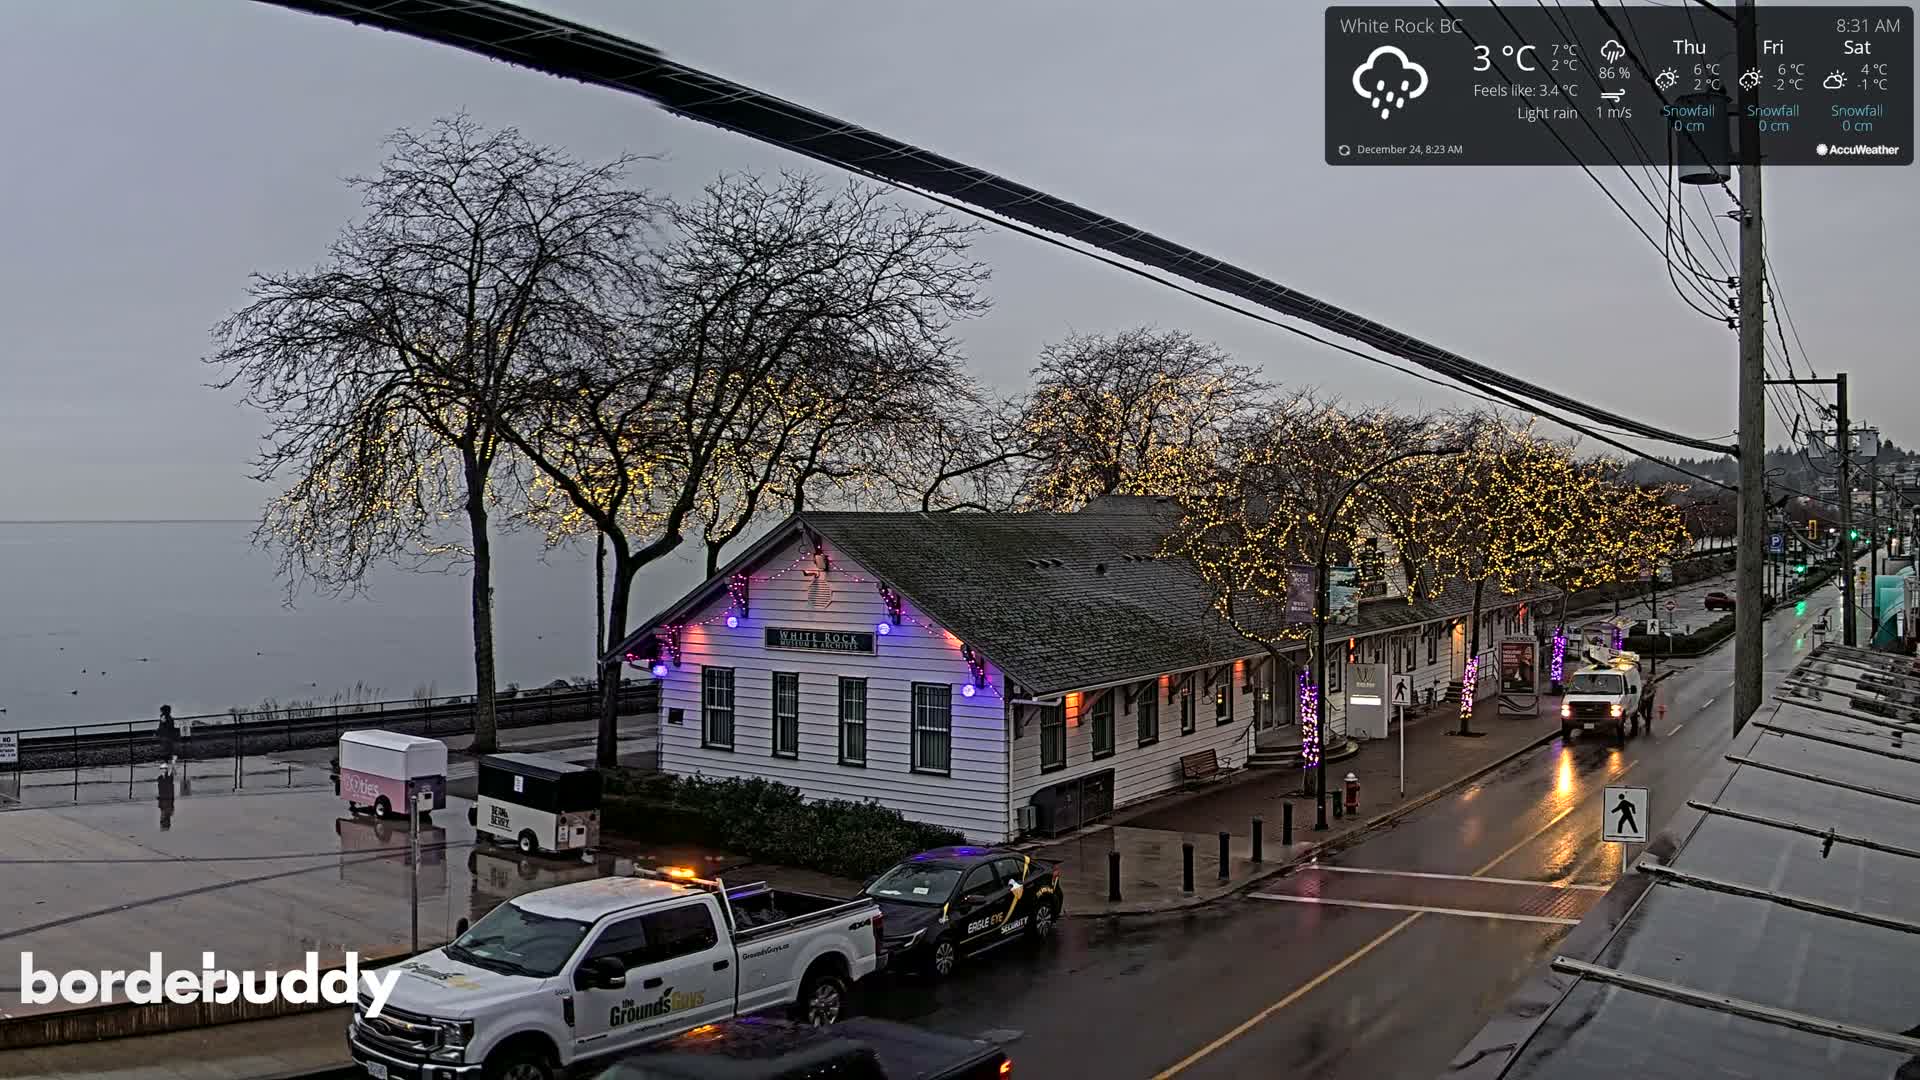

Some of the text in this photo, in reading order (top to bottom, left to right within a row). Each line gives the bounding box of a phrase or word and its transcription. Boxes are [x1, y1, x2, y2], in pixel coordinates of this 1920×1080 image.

[780, 630, 857, 644] WHITE ROCK
[780, 639, 810, 647] MUSEUM
[821, 642, 858, 650] ARCHIVES
[967, 912, 1004, 934] EAGLE EYE
[1001, 916, 1029, 934] SECURITY
